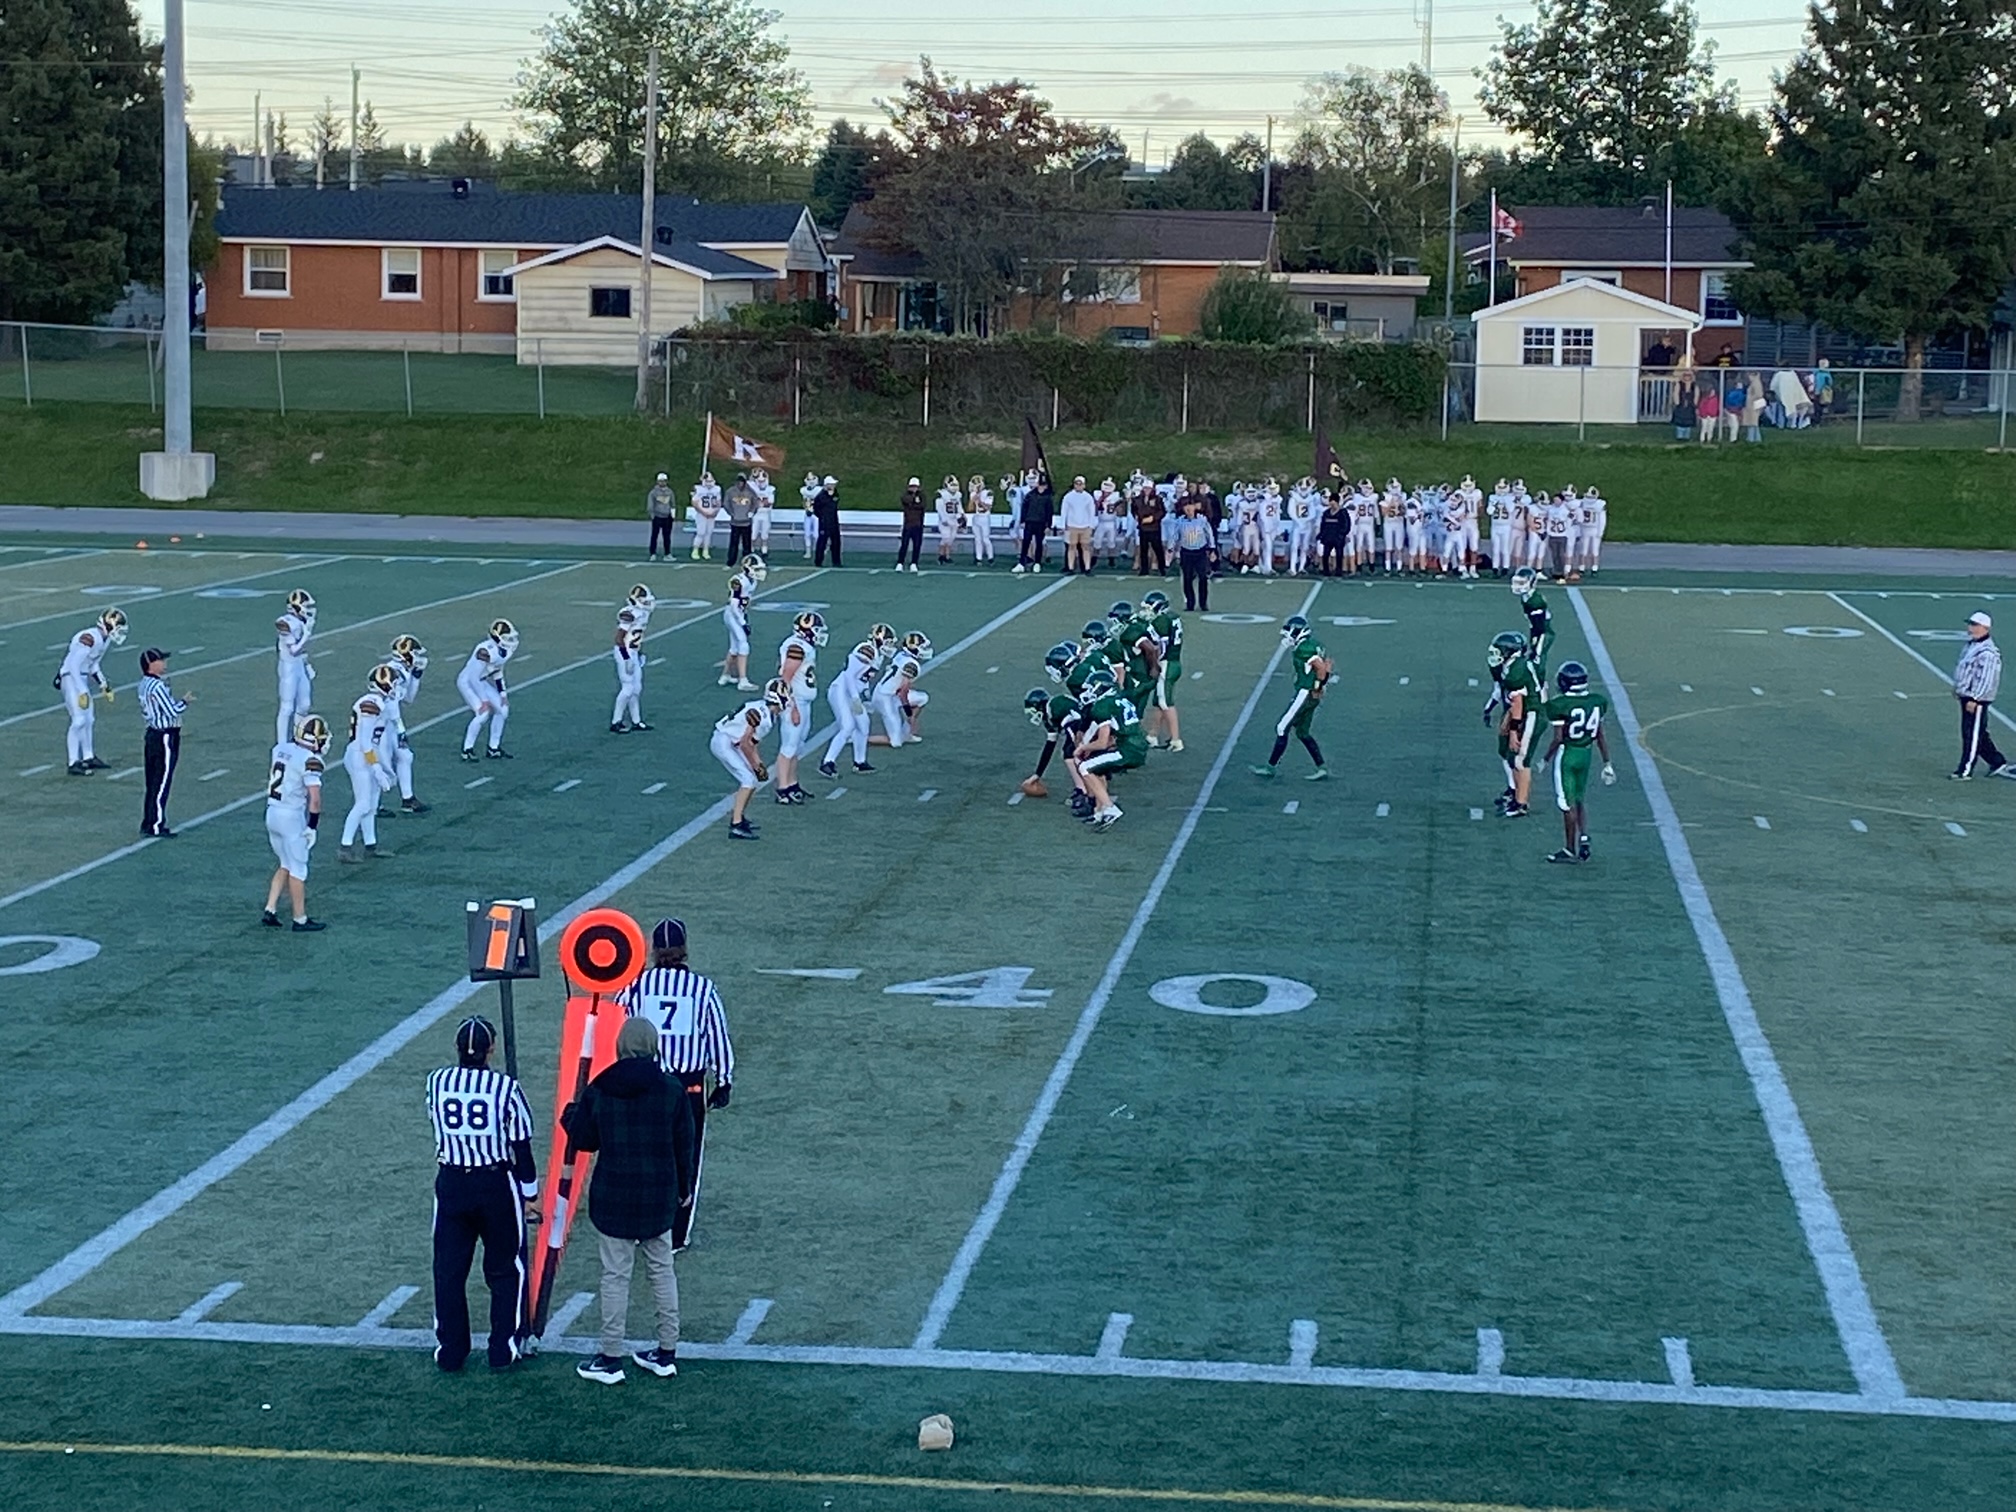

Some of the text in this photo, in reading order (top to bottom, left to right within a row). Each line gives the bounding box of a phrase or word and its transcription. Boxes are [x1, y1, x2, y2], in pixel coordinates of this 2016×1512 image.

[731, 434, 766, 463] K
[1568, 706, 1600, 739] 24
[658, 1000, 678, 1031] 7
[442, 1097, 490, 1131] 88
